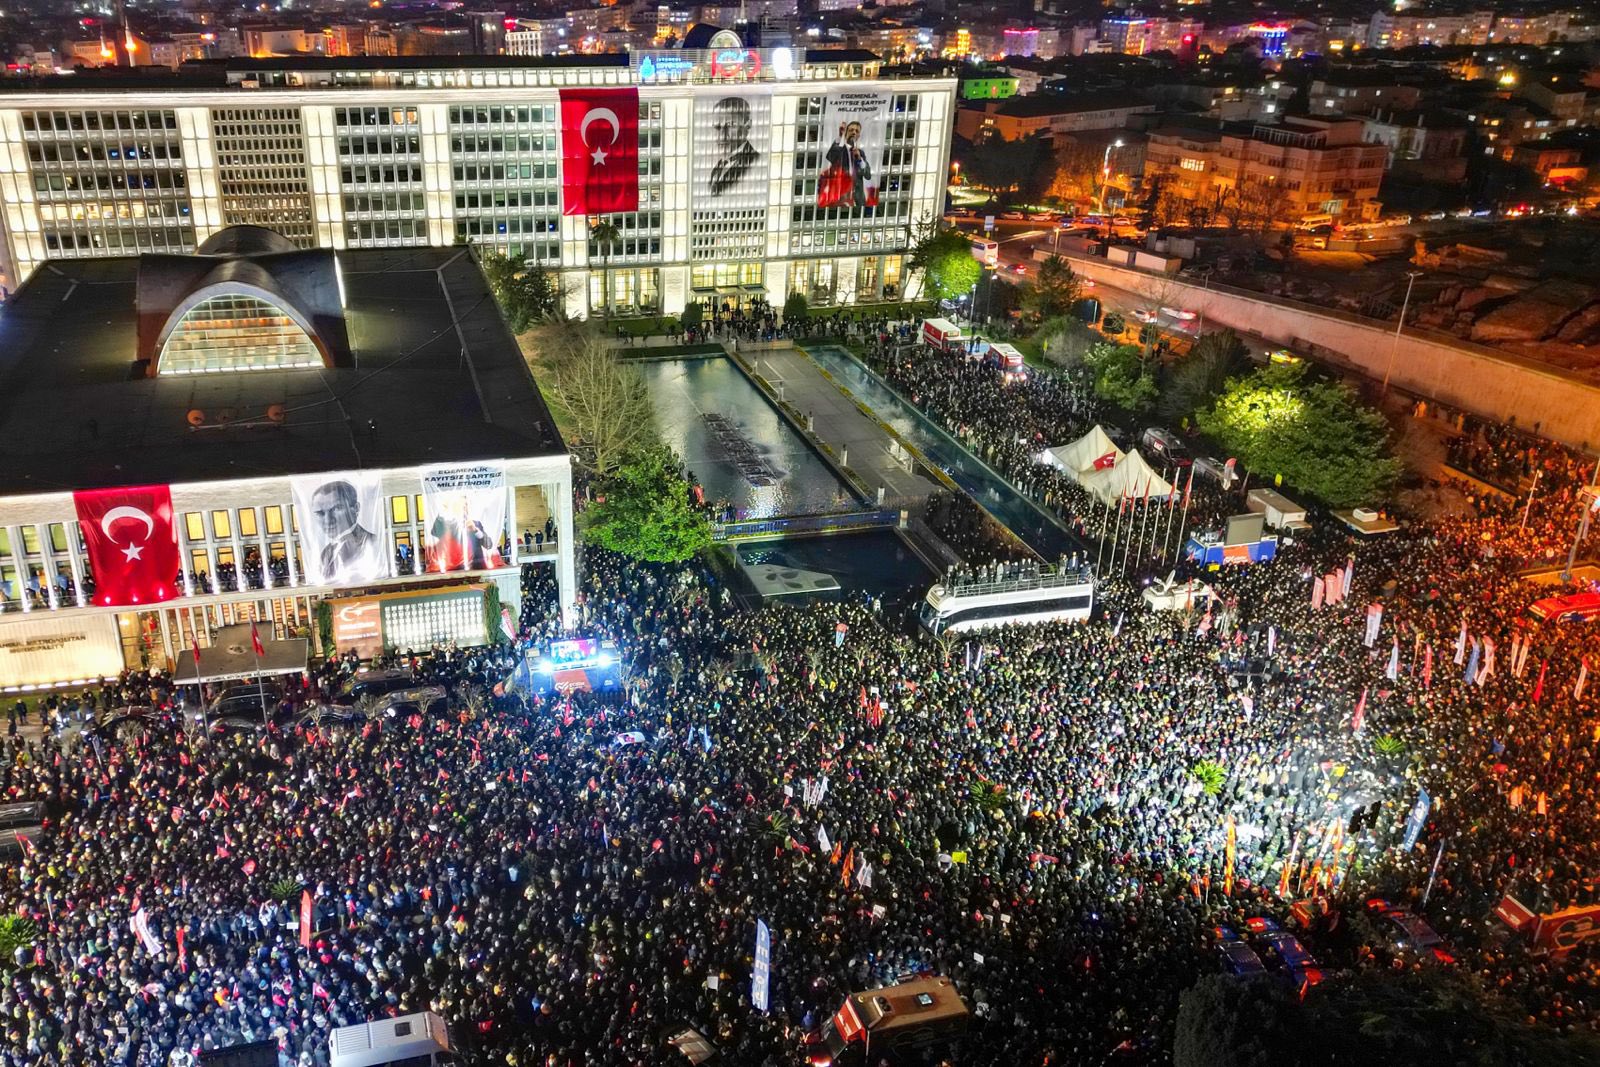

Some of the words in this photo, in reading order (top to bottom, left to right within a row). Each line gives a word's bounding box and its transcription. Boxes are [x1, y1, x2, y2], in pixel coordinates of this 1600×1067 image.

[425, 474, 464, 482] KAYITSIZ
[466, 472, 502, 480] ŞARTSIZ
[437, 480, 491, 488] MİLLETİNDİR
